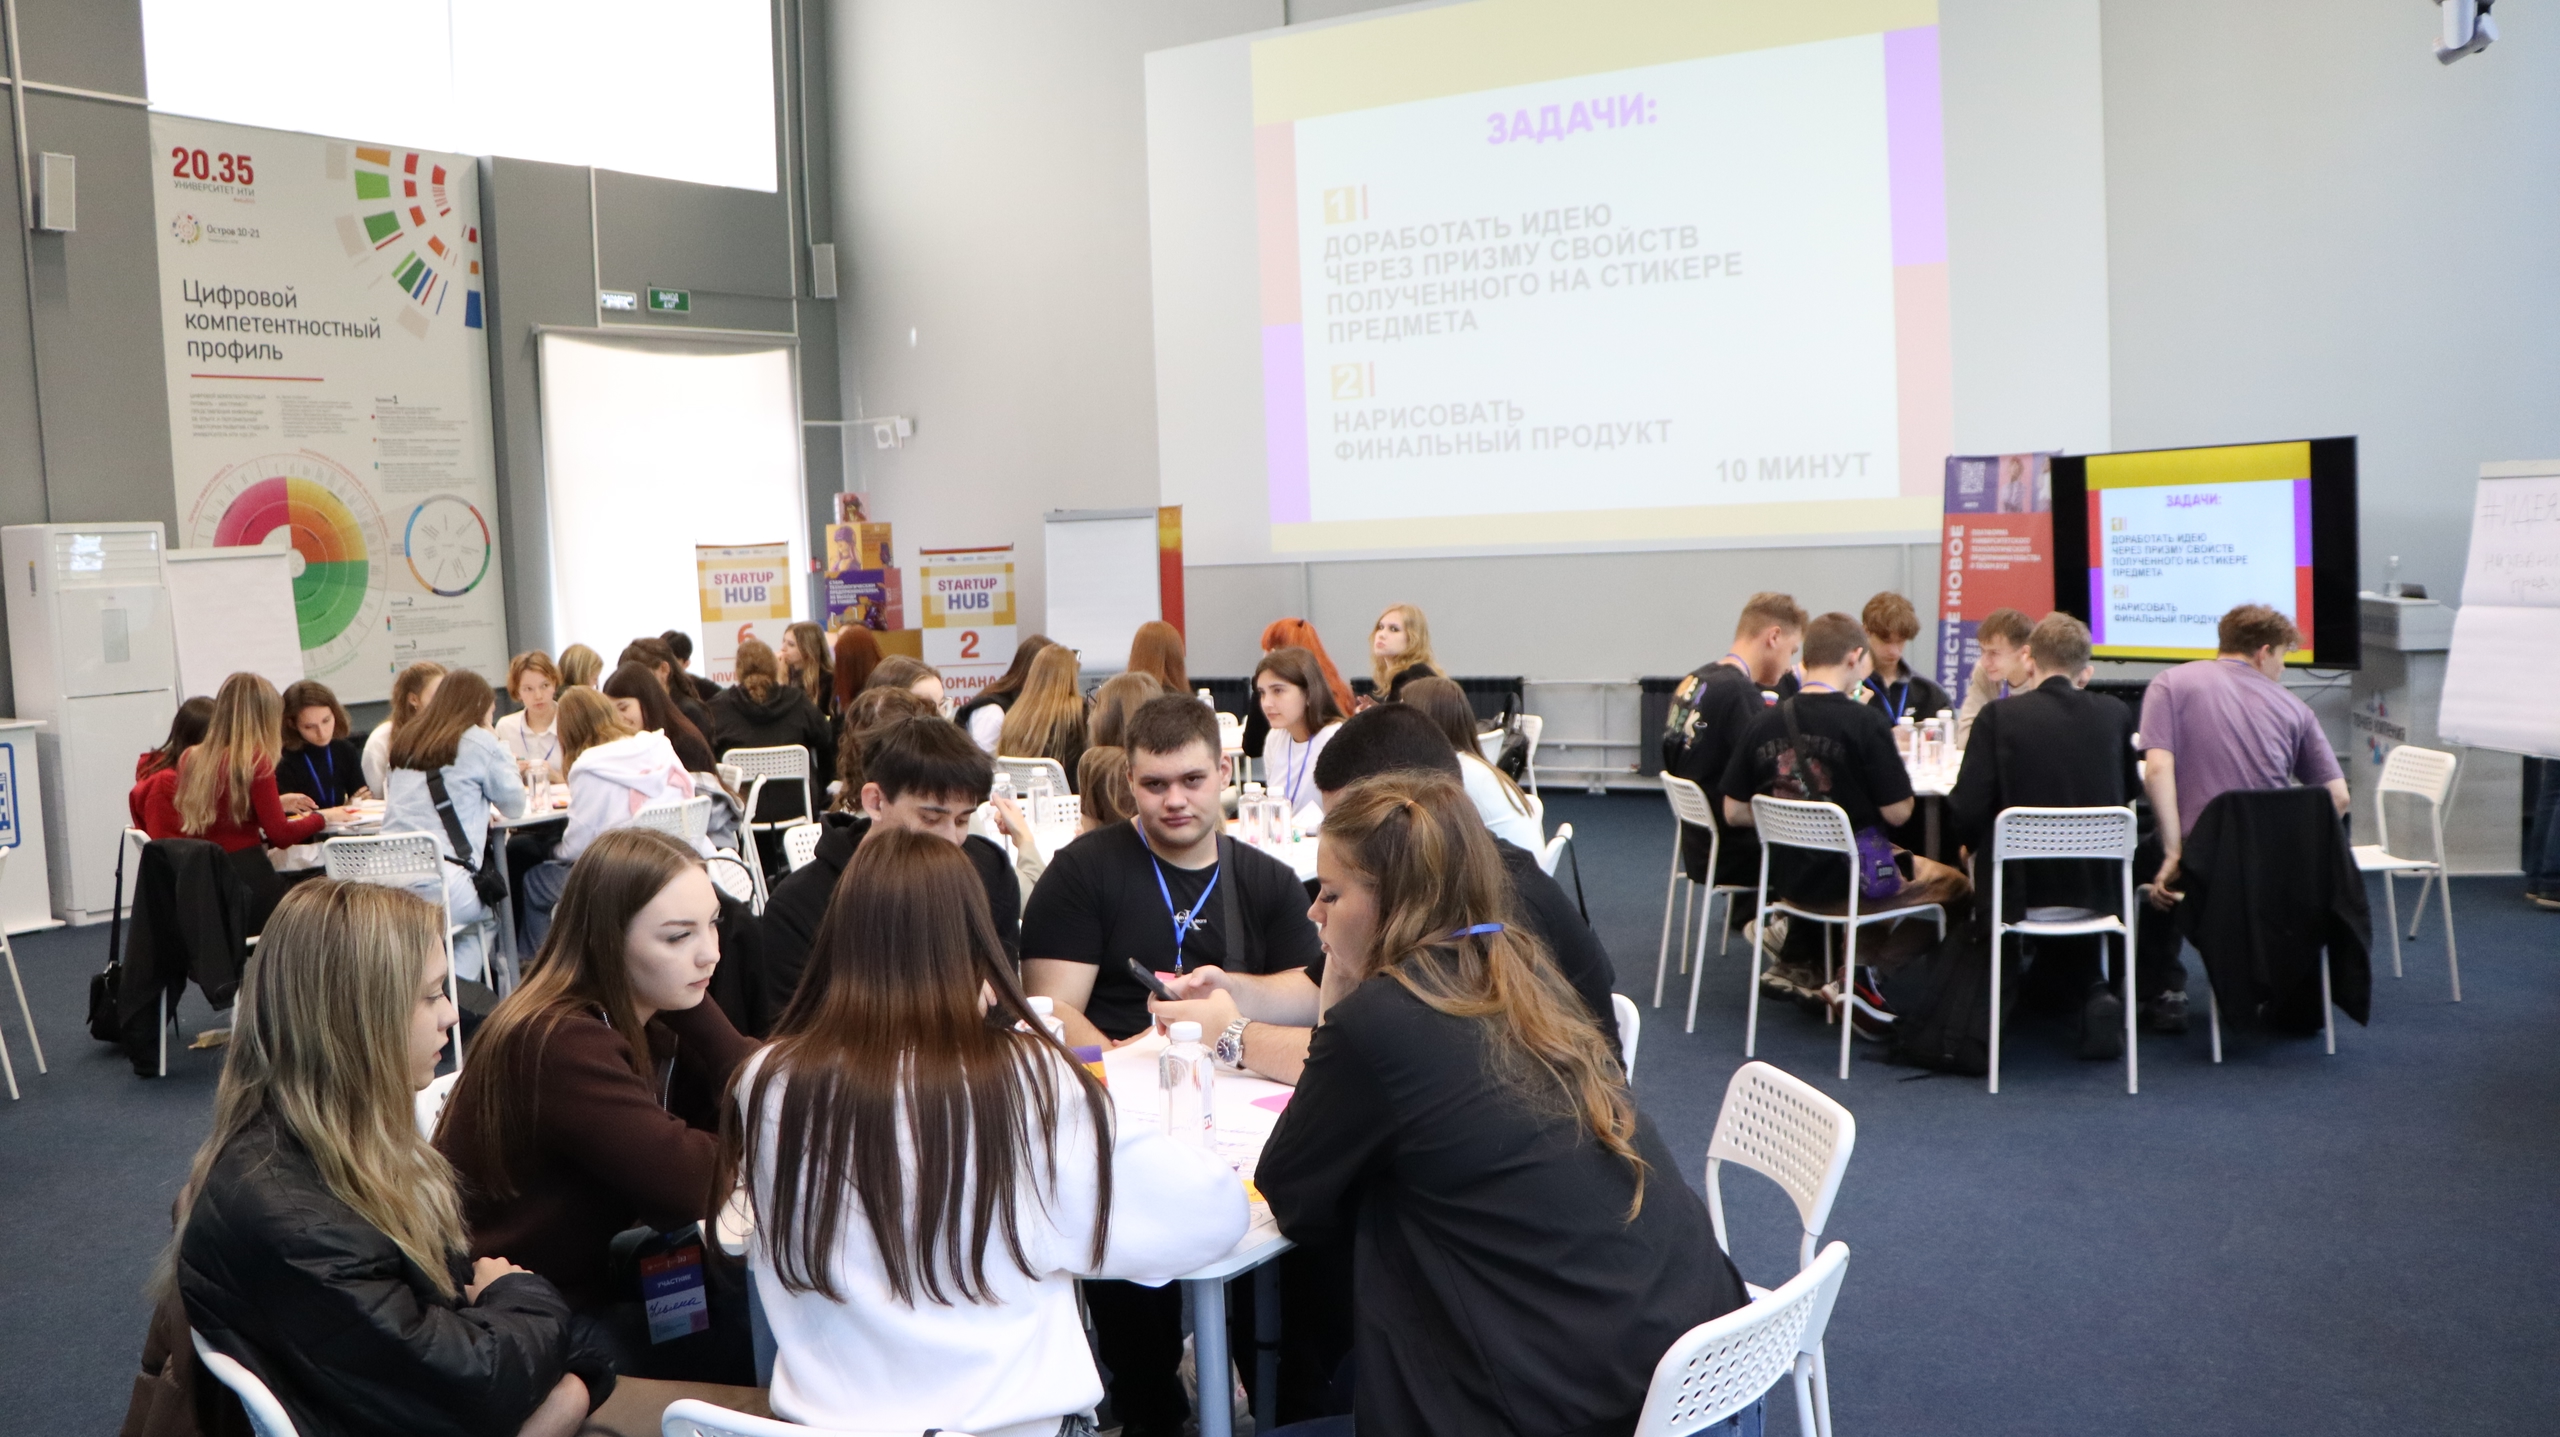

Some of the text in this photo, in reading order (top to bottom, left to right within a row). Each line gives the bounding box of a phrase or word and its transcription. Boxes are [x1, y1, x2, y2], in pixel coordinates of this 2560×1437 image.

[1487, 92, 1657, 145] ЗАДАЧИ:
[172, 146, 254, 185] 20.35
[174, 180, 255, 197] УНИВЕРСИТЕТ НТИ
[1330, 189, 1348, 221] 1
[207, 224, 261, 239] Остров 10-21
[1324, 202, 1612, 263] ДОРАБОТАТЬ ИДЕЮ
[1326, 225, 1699, 286] ЧЕРЕЗ ПРИЗМУ СВОЙСТВ
[183, 279, 298, 309] Цифровой
[1327, 251, 1743, 316] ПОЛУЧЕННОГО НА СТИКЕРЕ
[185, 313, 381, 339] компетентностный
[1328, 310, 1479, 344] ПРЕДМЕТА
[187, 339, 284, 363] профиль
[1336, 366, 1359, 398] 2
[1334, 399, 1525, 433] НАРИСОВАТЬ
[1335, 418, 1673, 462] ФИНАЛЬНЫЙ ПРОДУКТ
[1716, 452, 1871, 484] 10 МИНУТ
[2166, 493, 2222, 508] ЗАДАЧИ:
[2112, 532, 2207, 546] ДОРАБОТАТЬ ИДЕЮ
[2112, 543, 2235, 555] ЧЕРЕЗ ПРИЗМУ СВОЙСТВ
[1947, 525, 1964, 606] НОВОЕ
[2112, 555, 2249, 567] ПОЛУЧЕННОГО НА СТИКЕРЕ
[2112, 567, 2164, 578] ПРЕДМЕТА
[714, 571, 774, 585] STARTUP
[938, 578, 998, 591] STARTUP
[724, 585, 767, 604] HUB
[948, 592, 990, 610] HUB
[2114, 602, 2178, 613] НАРИСОВАТЬ
[2114, 613, 2222, 625] ФИНАЛЬНЫЙ ПРОДУК
[960, 631, 980, 659] 2
[656, 1273, 692, 1289] УЧАСТНИК
